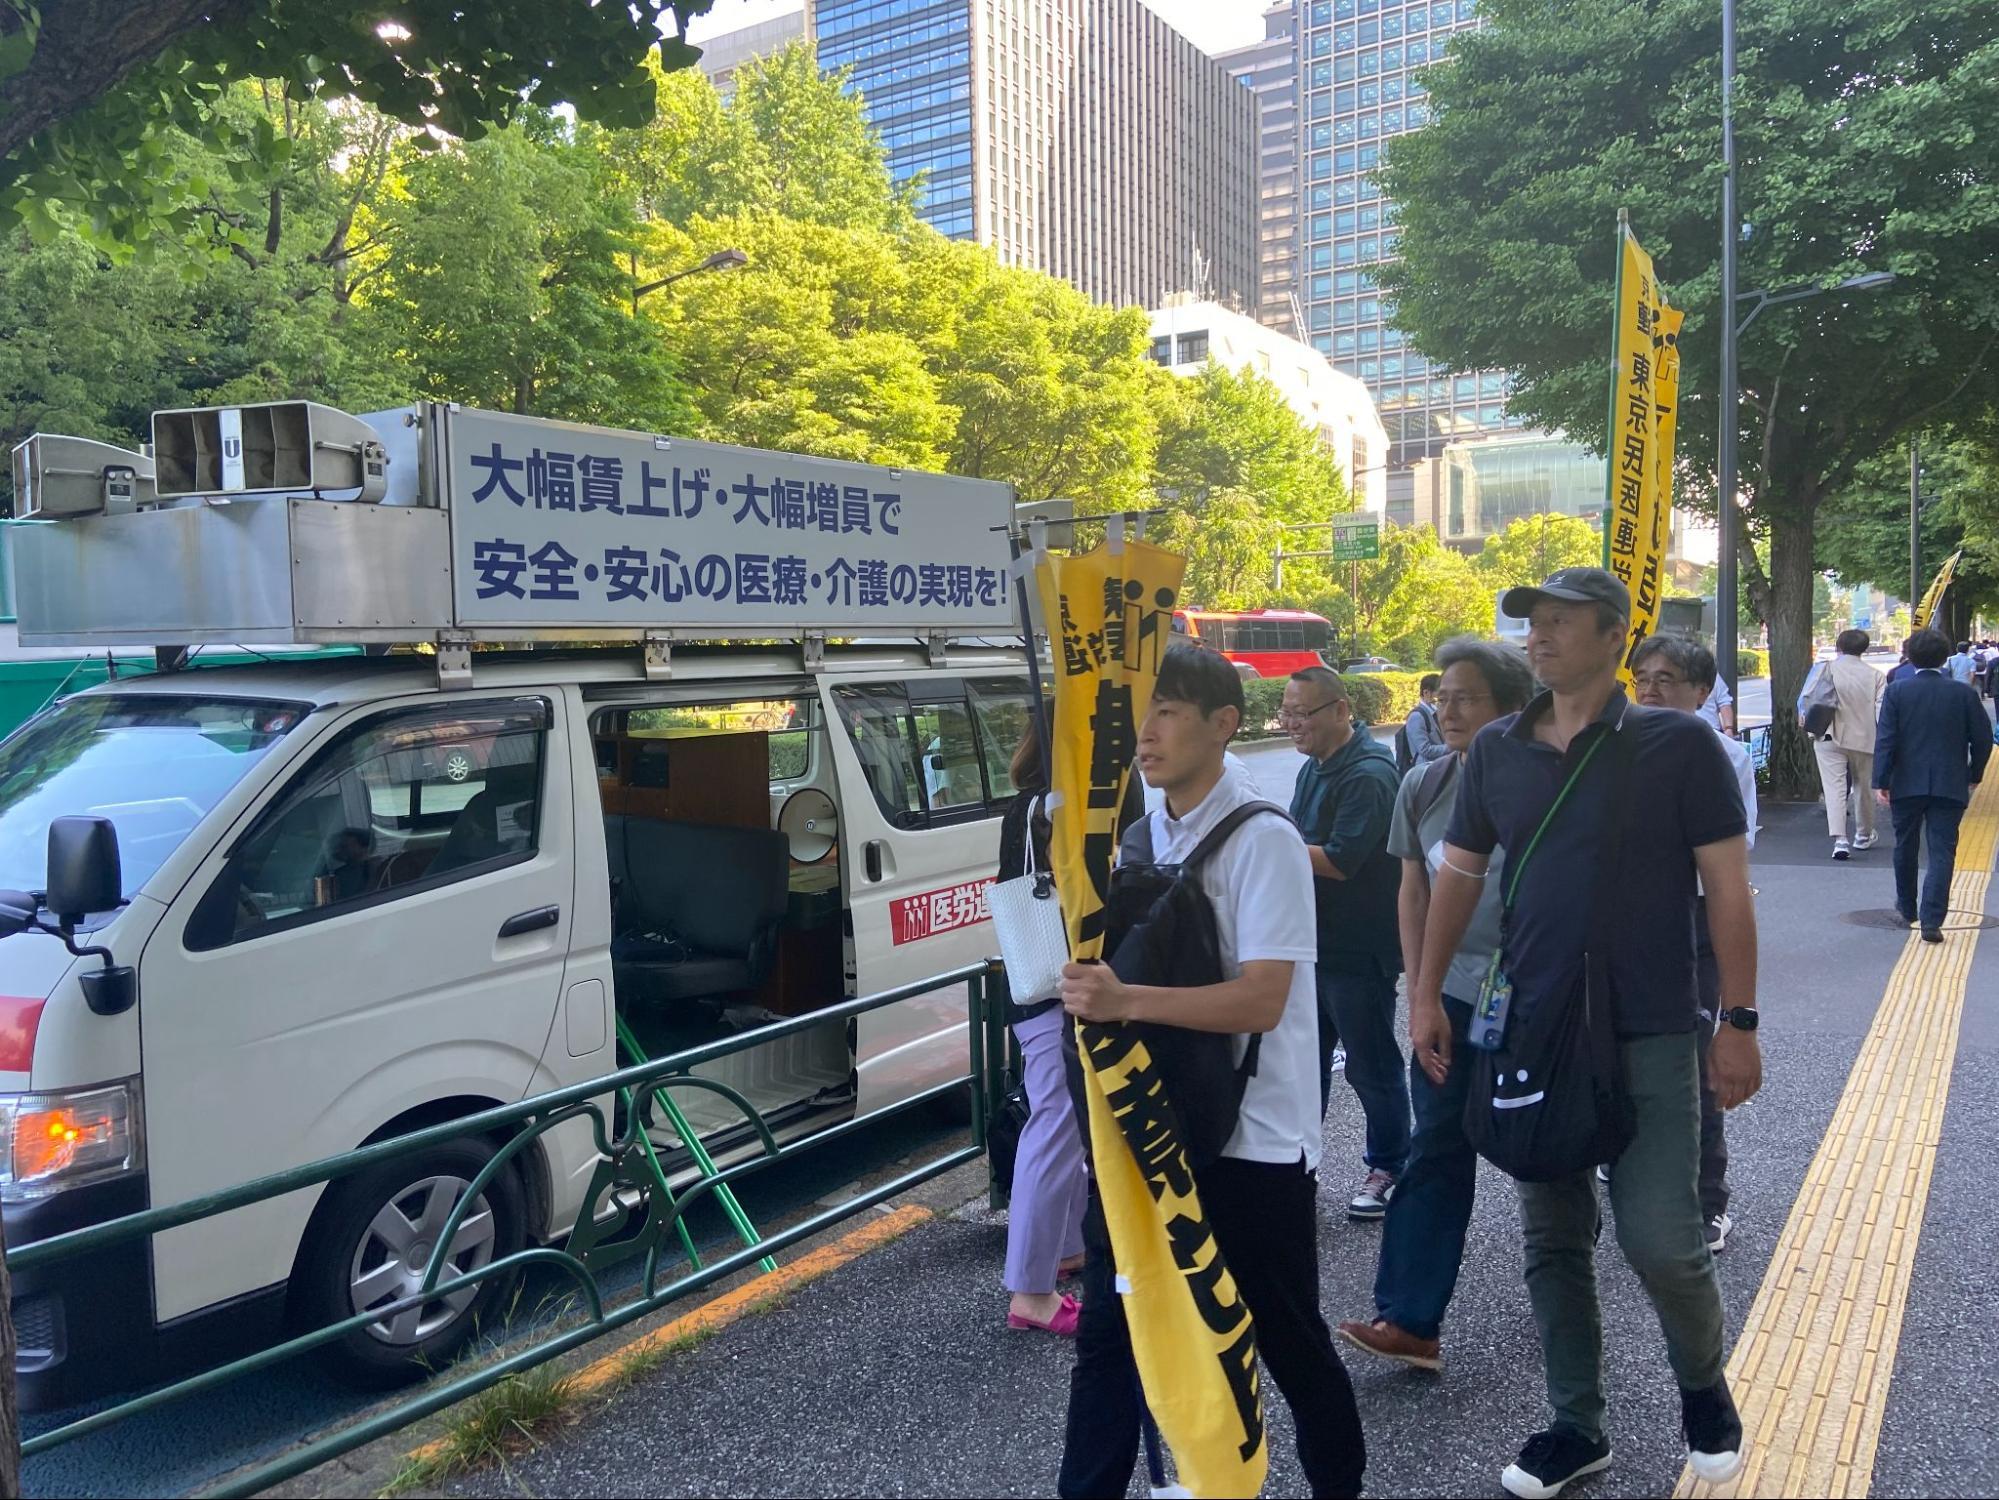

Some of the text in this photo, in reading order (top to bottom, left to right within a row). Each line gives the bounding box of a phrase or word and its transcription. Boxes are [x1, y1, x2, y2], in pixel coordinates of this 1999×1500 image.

[470, 442, 901, 536] 大幅賃上げ・大幅増員で
